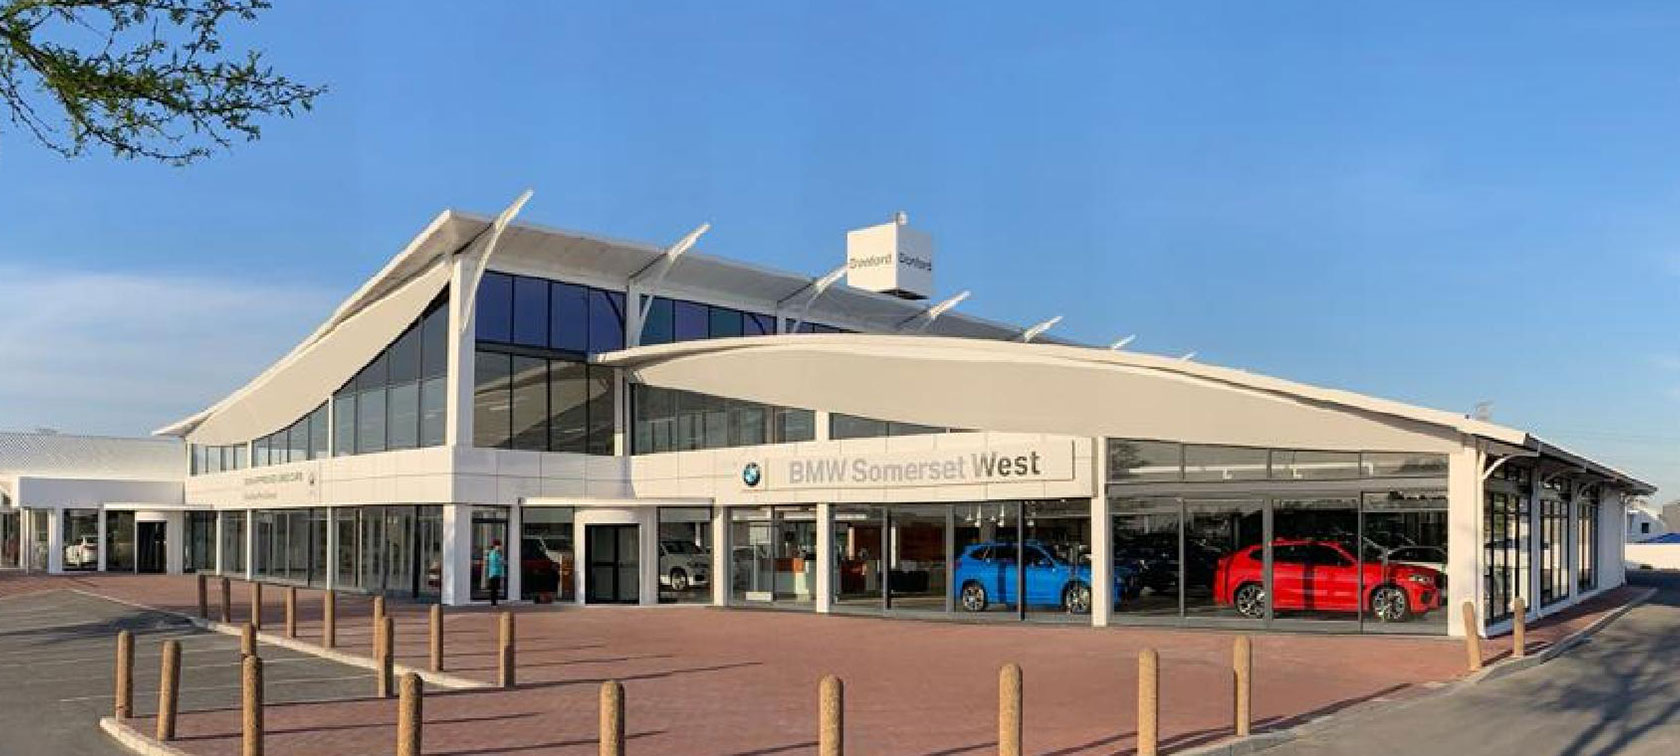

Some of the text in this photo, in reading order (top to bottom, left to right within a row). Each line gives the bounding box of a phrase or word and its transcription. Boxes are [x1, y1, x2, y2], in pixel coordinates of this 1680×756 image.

[788, 459, 847, 484] BMW
[852, 455, 966, 483] Somerset
[971, 450, 1041, 478] West
